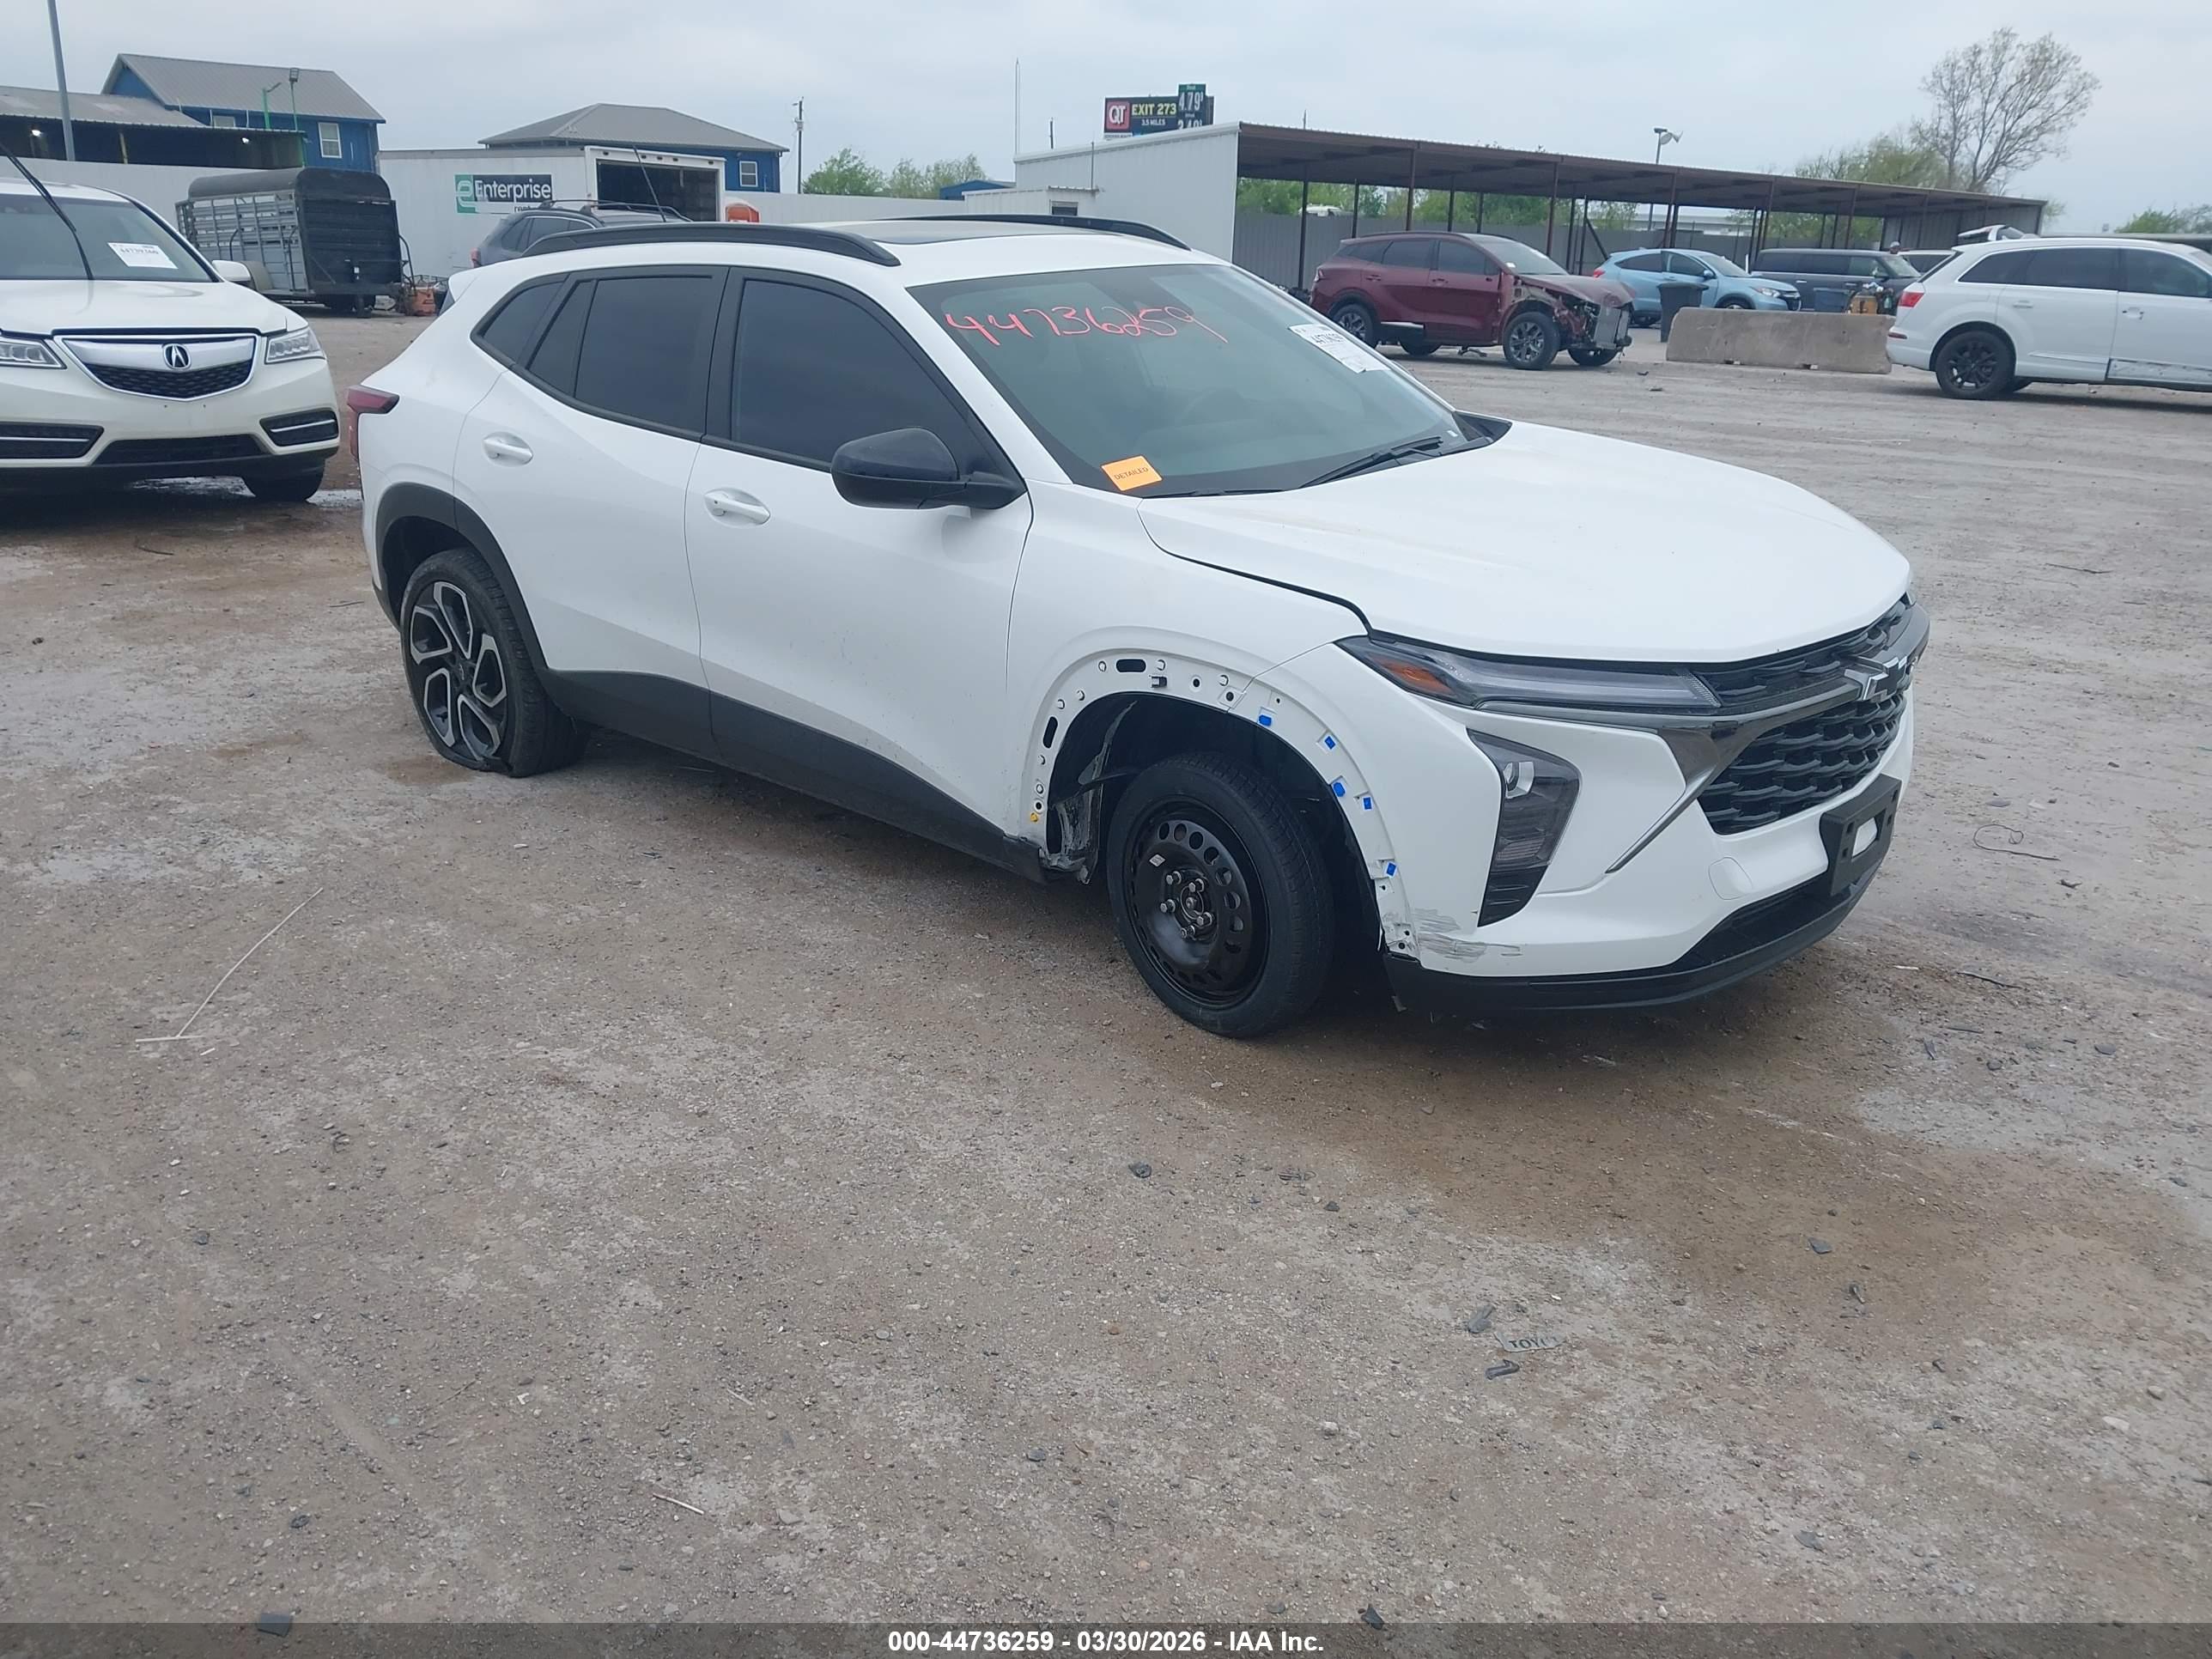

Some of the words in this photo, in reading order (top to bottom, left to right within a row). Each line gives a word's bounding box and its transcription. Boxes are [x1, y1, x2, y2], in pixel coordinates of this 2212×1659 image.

[1109, 105, 1126, 125] QT
[1132, 103, 1156, 115] EXIT
[1157, 103, 1177, 115] 273
[474, 179, 551, 203] Enterprise
[945, 307, 1229, 345] 44736259
[1114, 466, 1149, 480] DETAILED
